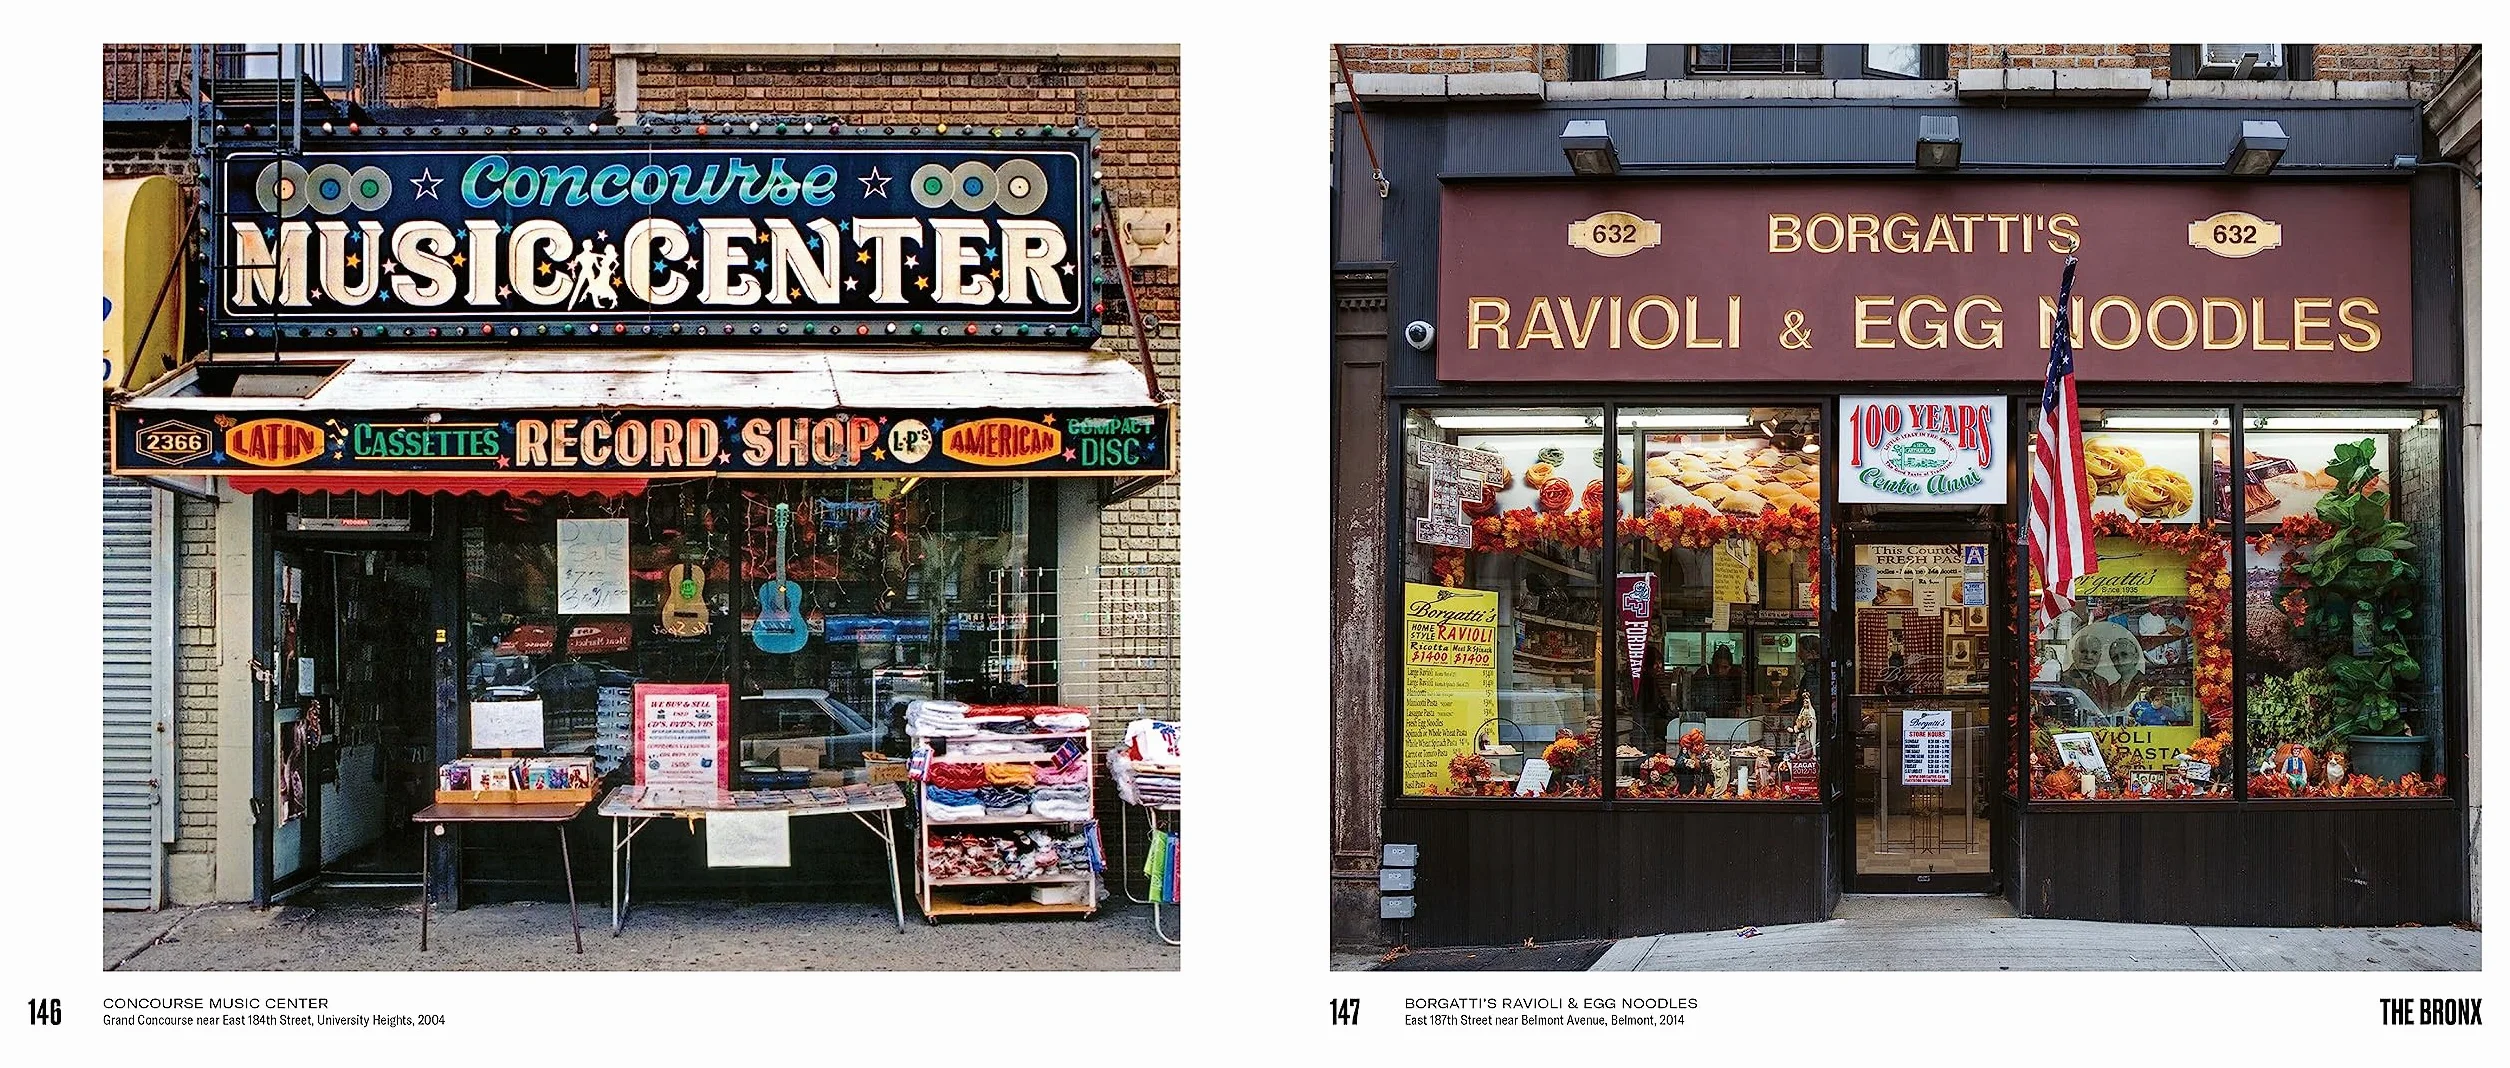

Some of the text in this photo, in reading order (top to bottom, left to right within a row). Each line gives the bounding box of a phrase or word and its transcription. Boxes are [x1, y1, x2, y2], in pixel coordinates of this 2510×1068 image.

[462, 155, 838, 209] Concourse
[1593, 224, 1637, 244] 632
[1769, 213, 2081, 254] BORGATTI'S
[2213, 224, 2258, 245] 632
[231, 217, 1072, 307] MUSIC CENTER
[1467, 294, 2382, 352] RAVIOLI & EGG NOODLES
[1067, 416, 1153, 436] COMPACT
[1850, 404, 1991, 469] 100 YEARS
[146, 434, 202, 452] 2366
[232, 421, 315, 461] LATIN
[353, 423, 500, 458] CASSETTES
[514, 416, 880, 468] RECORD SHOP
[949, 422, 1055, 459] AMERICAN
[1081, 437, 1141, 467] DISC
[1884, 437, 1901, 451] LITTLE
[1901, 432, 1918, 440] ITALY
[1857, 466, 1982, 495] Cento Anni
[1870, 545, 1903, 555] This
[1876, 555, 1964, 564] FRESH PAS
[1966, 546, 1984, 564] A
[2074, 568, 2158, 595] orgatti's
[1407, 600, 1497, 626] Borgatti's
[1410, 632, 1436, 641] STYLE
[1411, 623, 1493, 643] HOME RAVIOLI
[1410, 641, 1449, 652] Ricotta
[1625, 620, 1649, 679] FORDHAM
[2096, 731, 2152, 744] VIOLI
